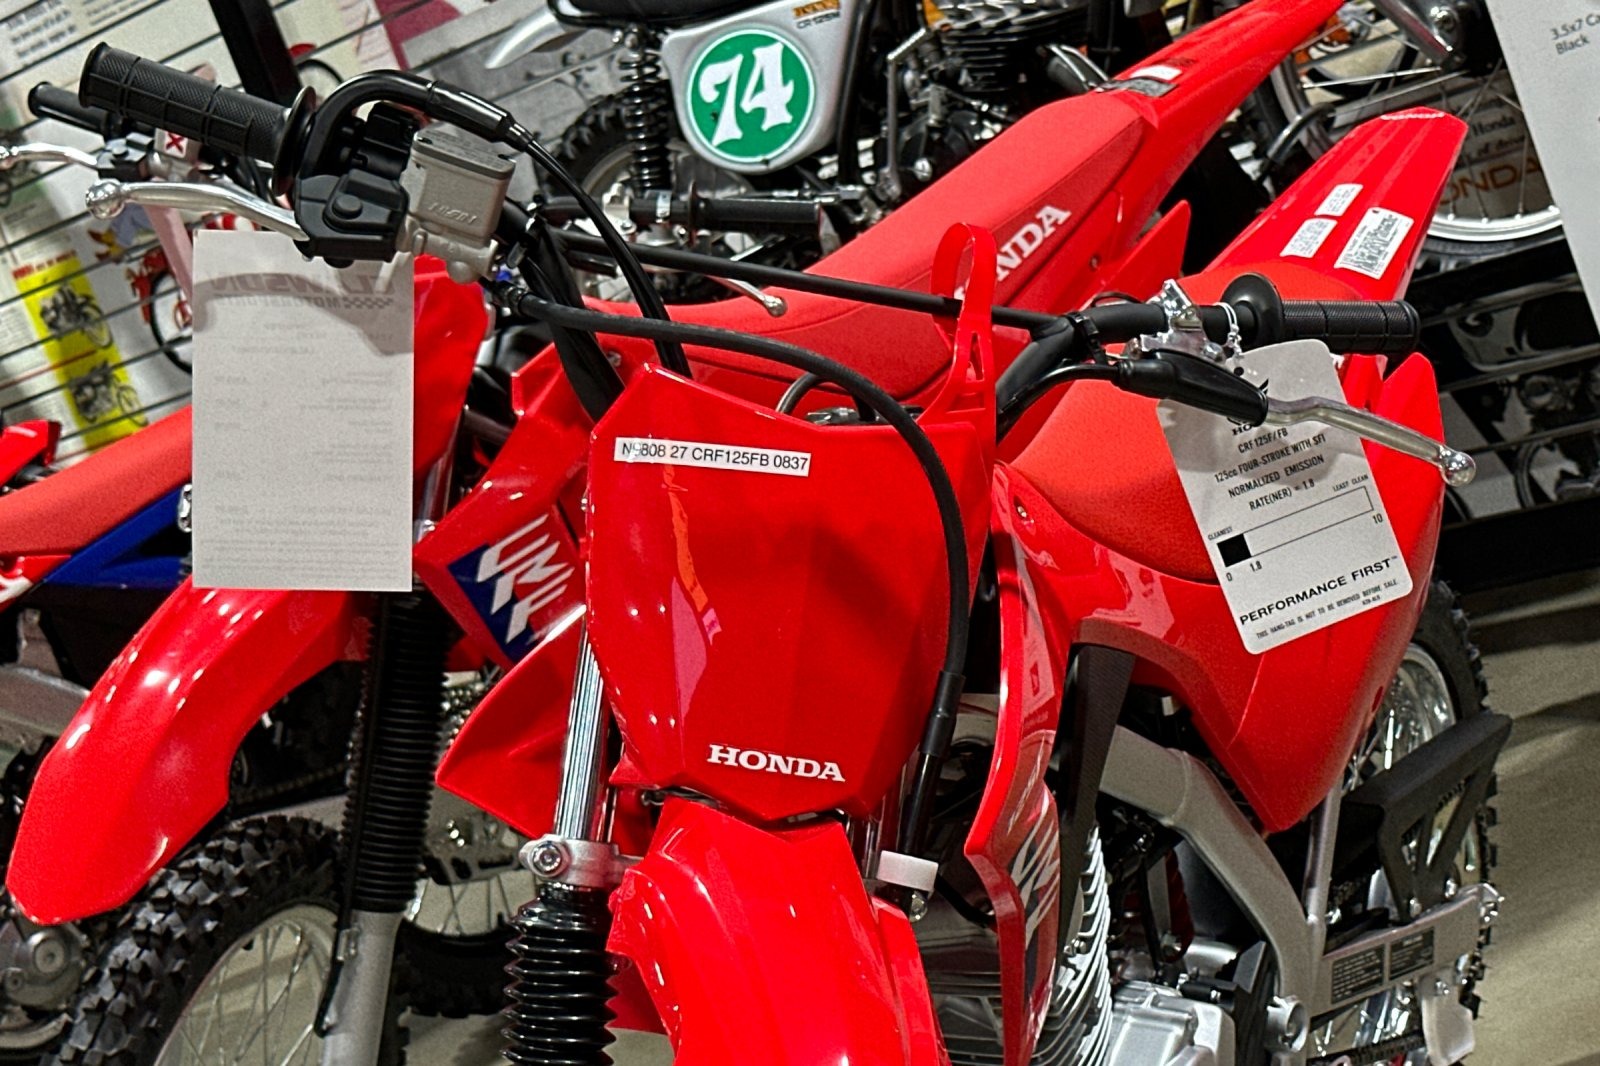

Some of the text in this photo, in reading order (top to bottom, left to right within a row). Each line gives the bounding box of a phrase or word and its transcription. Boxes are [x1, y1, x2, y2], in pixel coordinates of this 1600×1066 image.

[1555, 34, 1590, 55] Black
[699, 41, 794, 147] 74
[670, 445, 688, 460] 27
[692, 447, 770, 467] CRF125FB
[773, 454, 809, 471] 0837
[1214, 433, 1326, 483] 125cc FOUR-STROKE WITH SFI
[1228, 454, 1325, 498] NORMALIZED EMISSION
[1249, 486, 1292, 511] RATE(NER)
[1302, 478, 1315, 490] 1.8
[1372, 512, 1383, 524] 10
[1226, 572, 1233, 582] 0
[1250, 560, 1262, 572] 1.8
[1240, 575, 1347, 626] PERFORMANCE
[707, 744, 846, 782] HONDA
